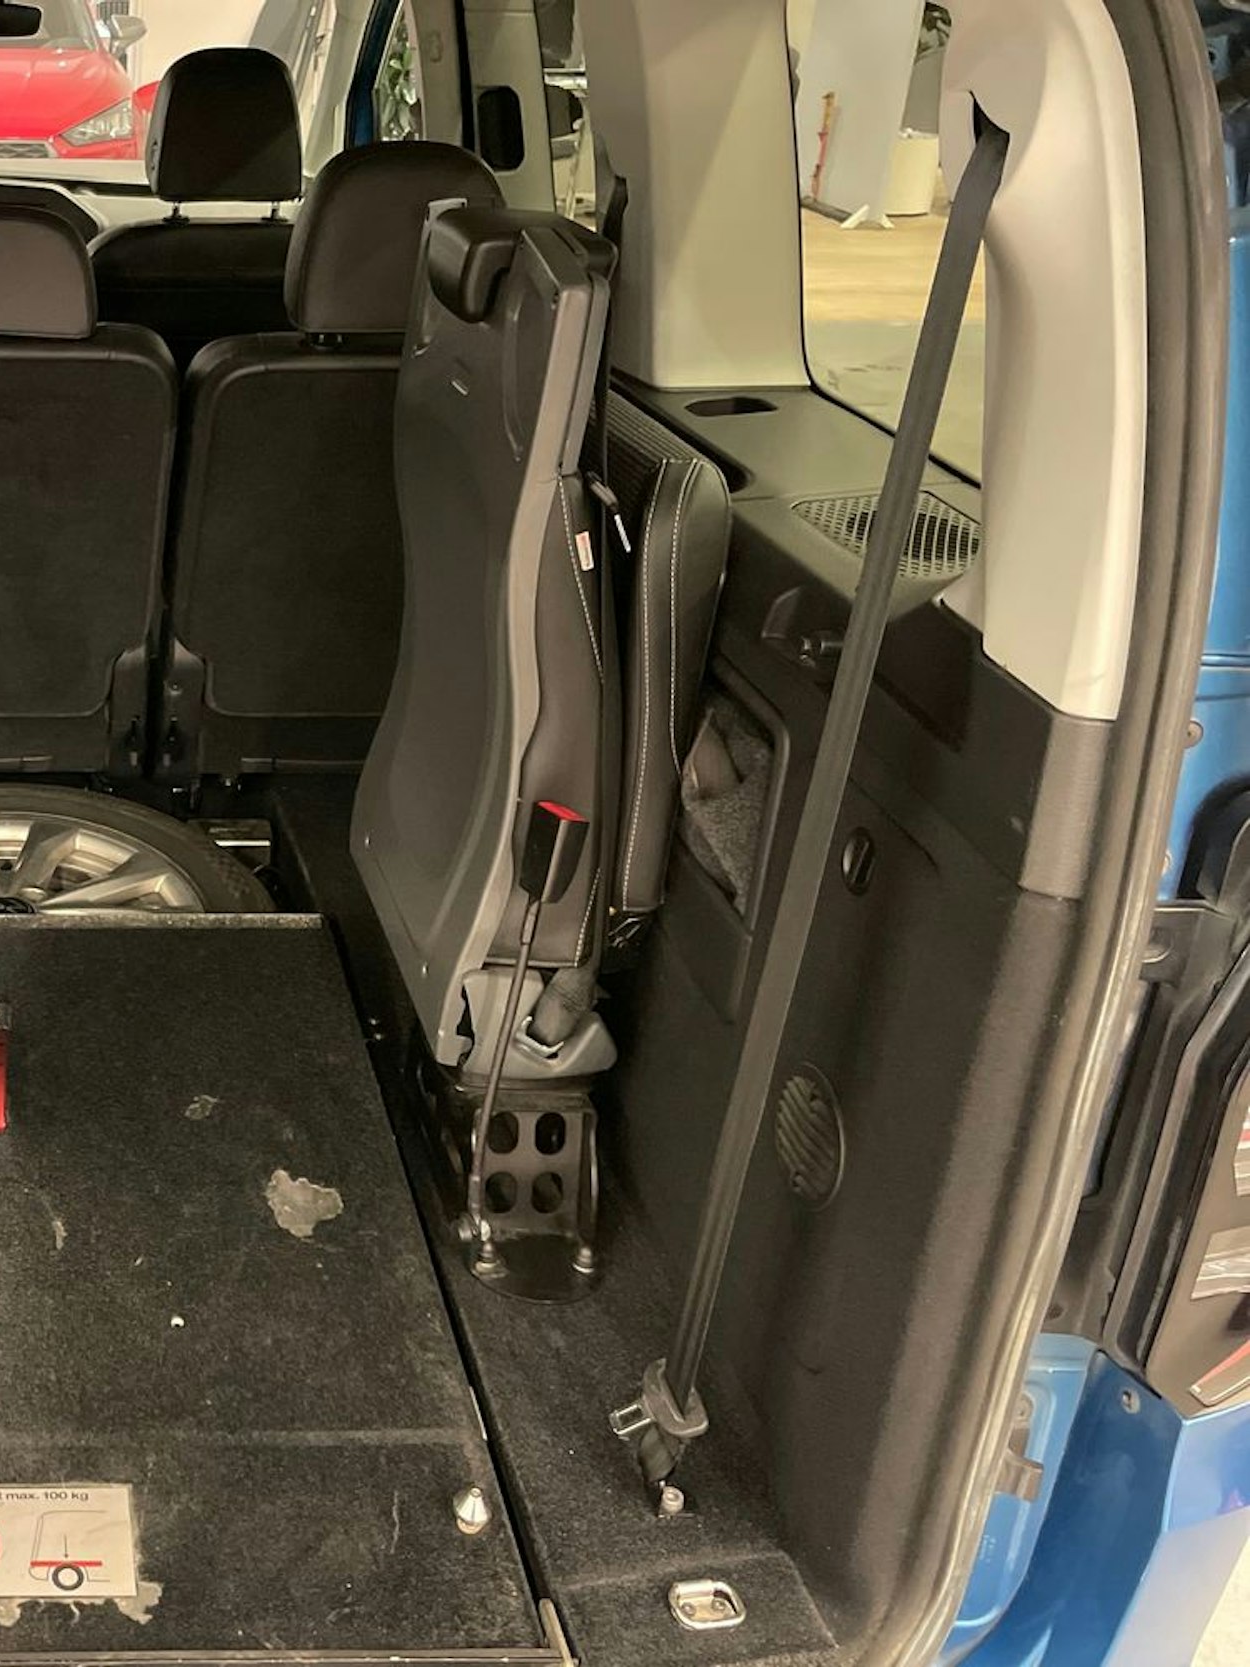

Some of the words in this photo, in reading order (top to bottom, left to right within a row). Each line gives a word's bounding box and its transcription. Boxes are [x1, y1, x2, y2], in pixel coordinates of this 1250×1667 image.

[6, 1492, 39, 1500] max.
[44, 1491, 67, 1500] 100
[71, 1491, 89, 1501] kg
